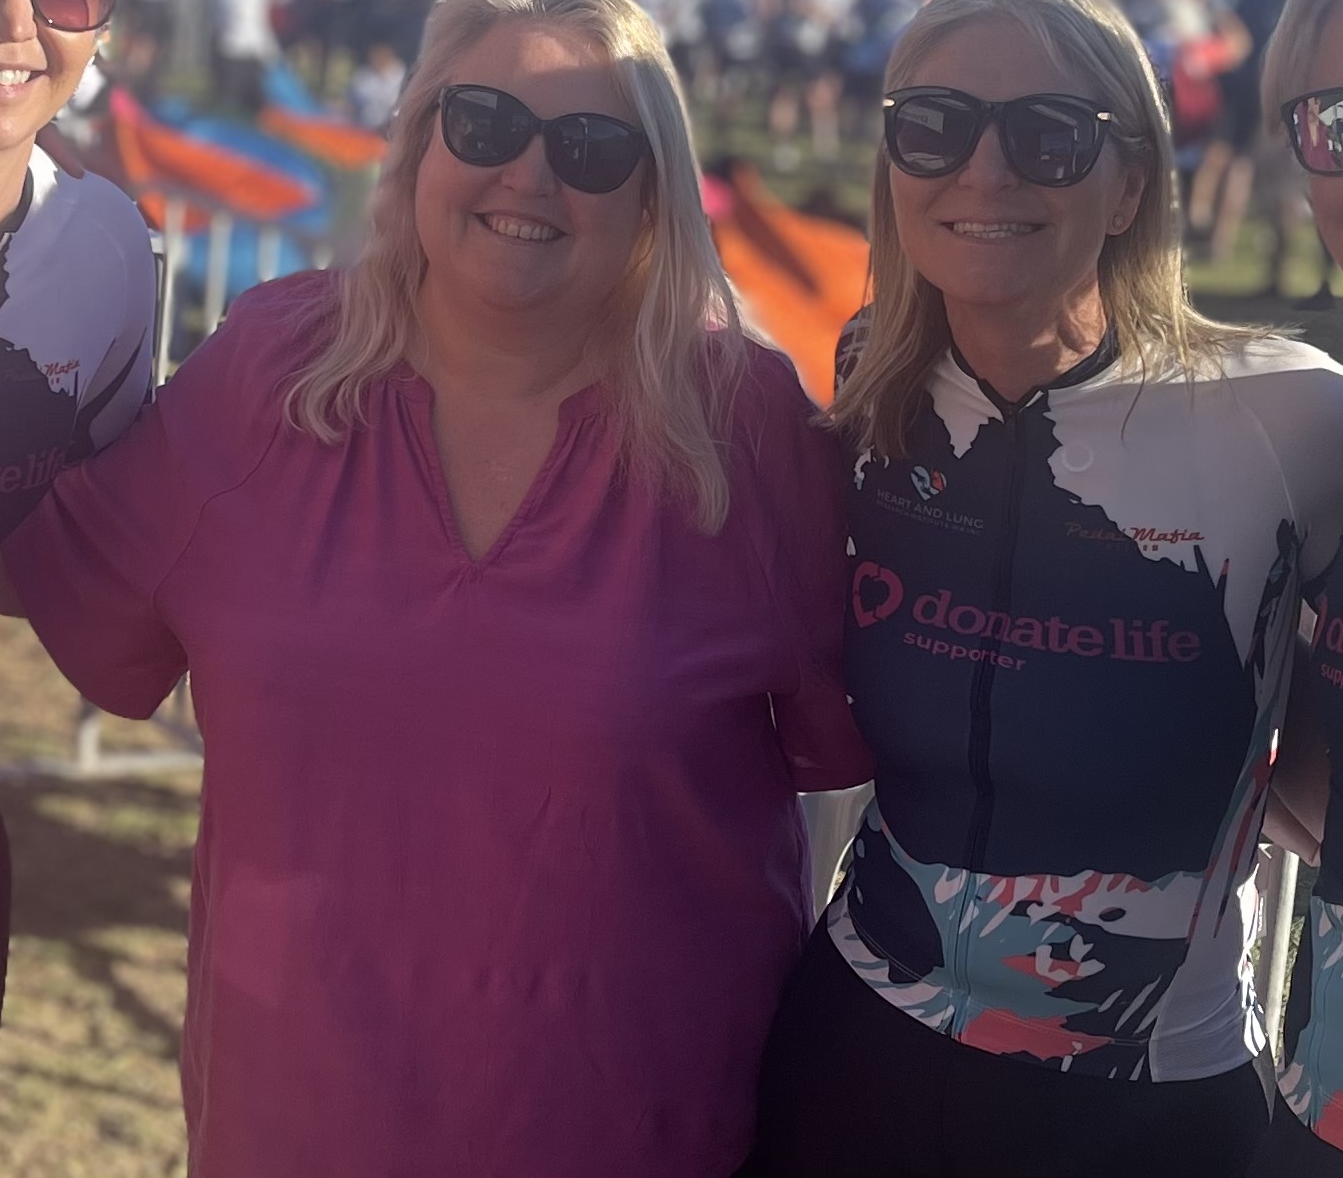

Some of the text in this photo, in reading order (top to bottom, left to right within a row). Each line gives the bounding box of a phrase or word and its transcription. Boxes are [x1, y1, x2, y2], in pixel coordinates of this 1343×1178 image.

[877, 488, 984, 529] HEART AND LUNG
[1131, 527, 1206, 544] Mafia
[912, 588, 1202, 664] donate life
[902, 630, 1027, 672] supporter
